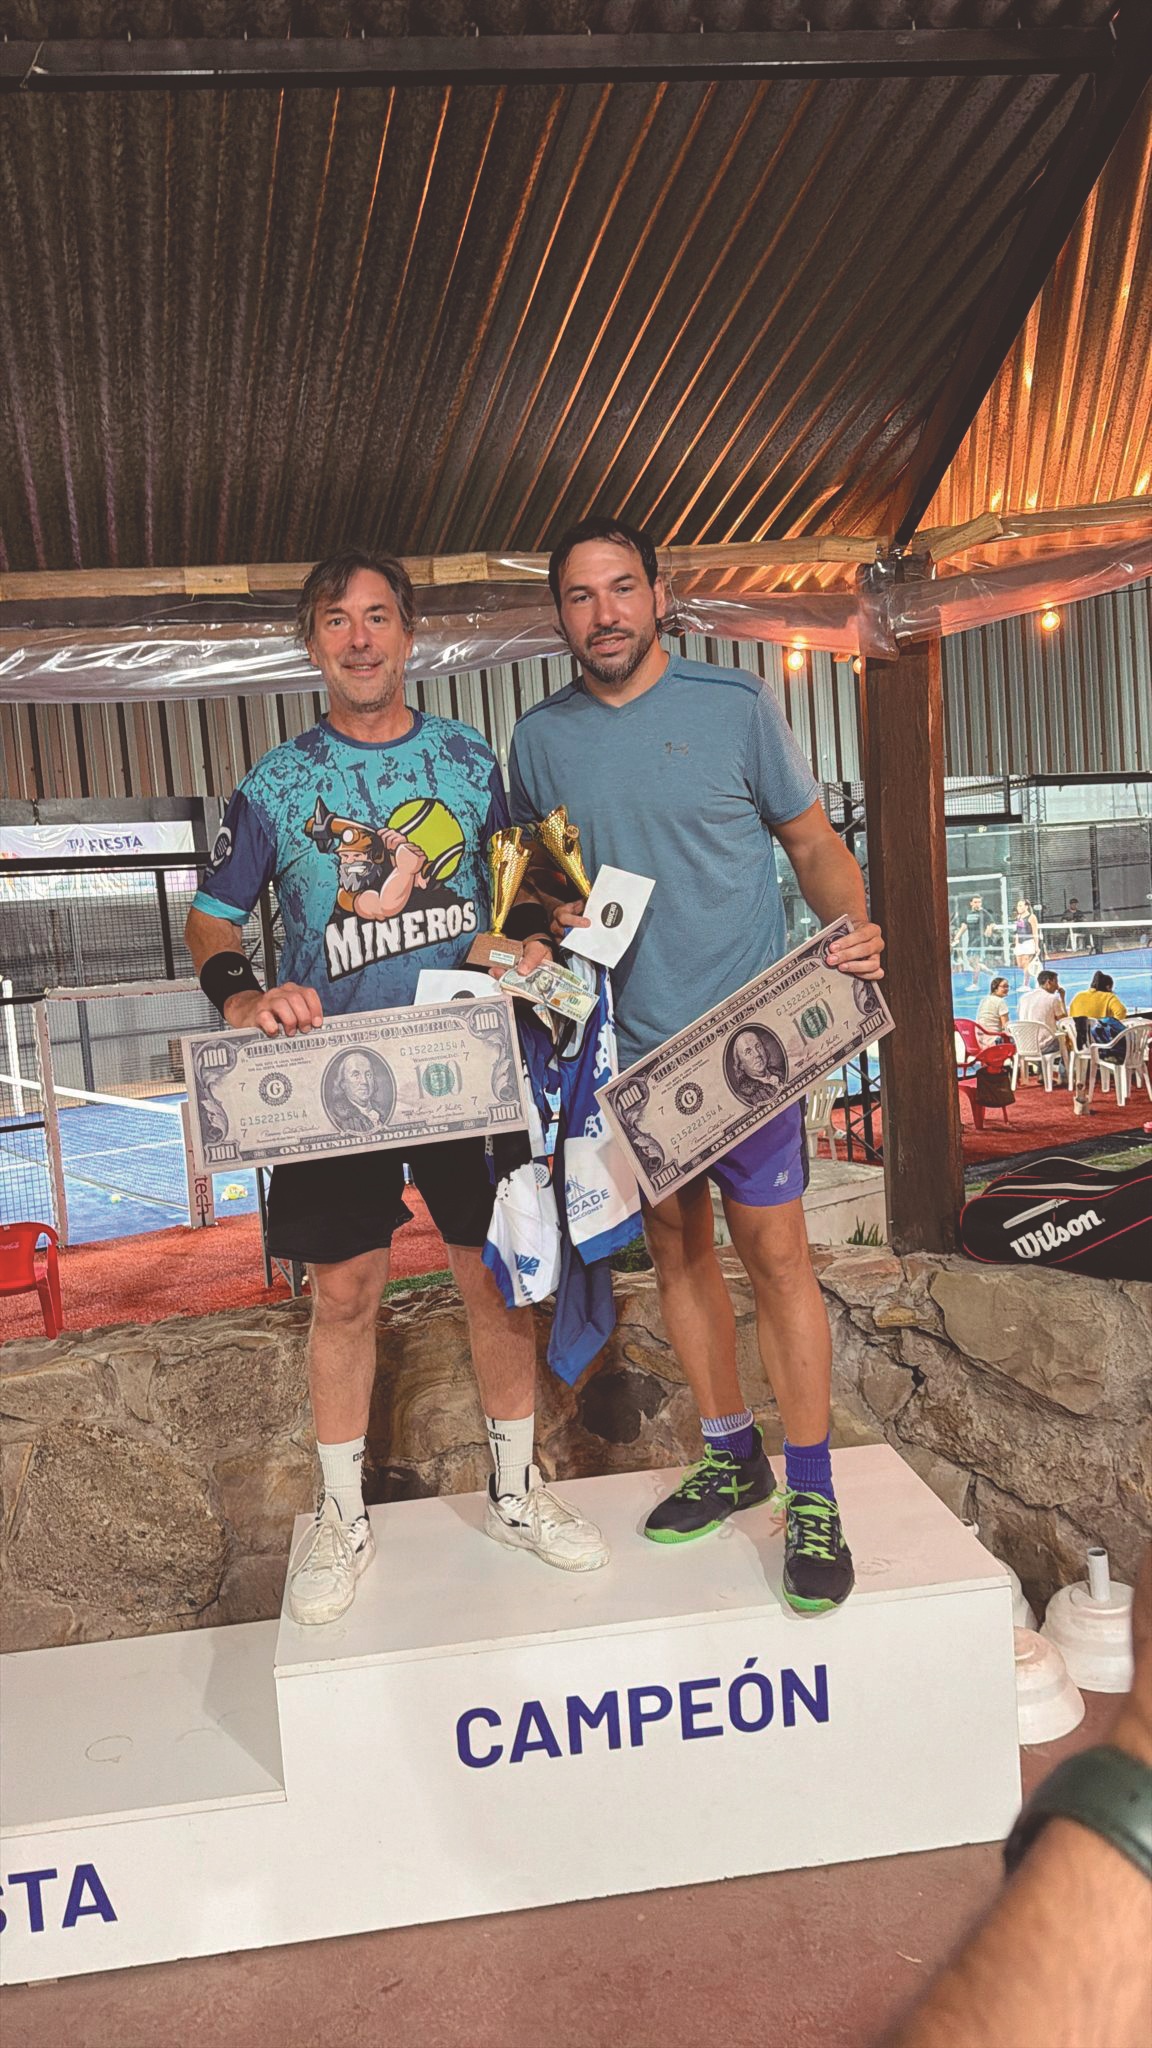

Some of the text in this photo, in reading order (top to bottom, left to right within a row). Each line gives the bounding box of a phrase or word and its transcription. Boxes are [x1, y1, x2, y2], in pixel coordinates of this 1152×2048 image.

[67, 835, 143, 852] TU FIESTA
[325, 901, 477, 977] MINEROS
[475, 1011, 499, 1031] 100
[651, 1060, 678, 1083] THE
[676, 1031, 717, 1066] UNITED
[715, 1003, 757, 1038] STATES
[756, 993, 773, 1009] OF
[771, 961, 819, 997] AMERICA
[861, 1013, 883, 1037] 100
[244, 1045, 275, 1058] THE
[278, 1038, 327, 1054] UNITED
[328, 1028, 380, 1046] STATES
[381, 1024, 400, 1040] OF
[400, 1018, 464, 1037] AMERICA
[203, 1048, 228, 1068] 100
[463, 1052, 470, 1061] 7
[240, 1082, 246, 1092] 7
[787, 1058, 836, 1097] DOLLARS
[269, 1082, 281, 1096] G
[618, 1084, 643, 1111] 100
[684, 1092, 695, 1106] G
[470, 1096, 478, 1106] 7
[491, 1105, 517, 1121] 100
[241, 1128, 248, 1138] 7
[279, 1124, 449, 1156] ONE HUNDRED DOLLARS
[210, 1145, 236, 1160] 100
[655, 1164, 680, 1190] 100
[1009, 1209, 1103, 1258] Wilson
[456, 1656, 830, 1768] CAMPEÓN
[0, 1863, 118, 1933] TA
